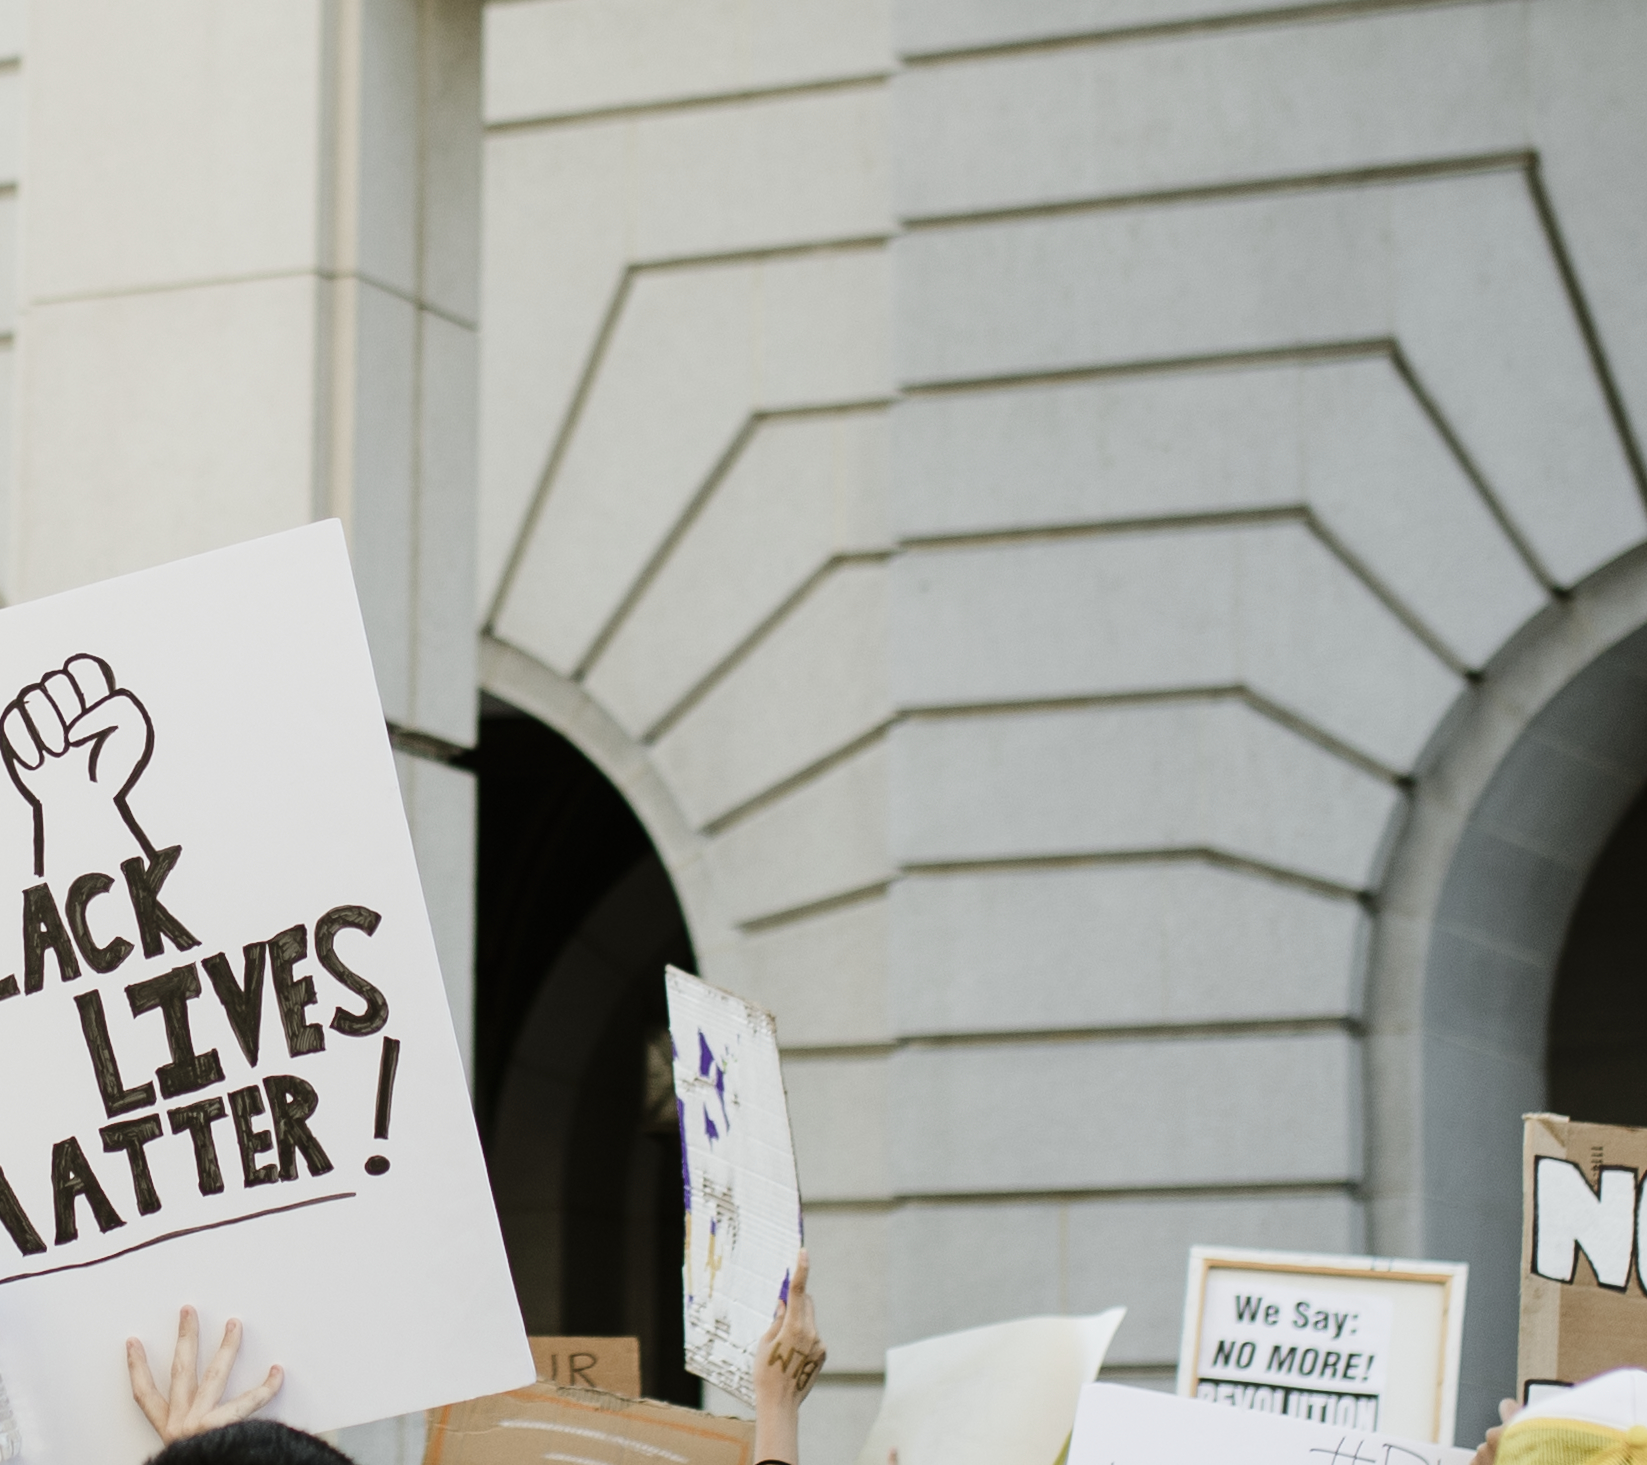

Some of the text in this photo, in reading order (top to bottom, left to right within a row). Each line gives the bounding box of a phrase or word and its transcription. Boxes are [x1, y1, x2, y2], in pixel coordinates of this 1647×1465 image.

[74, 904, 390, 1120] LIVES
[1235, 1294, 1359, 1340] We Say:
[1212, 1339, 1375, 1382] NO MORE!
